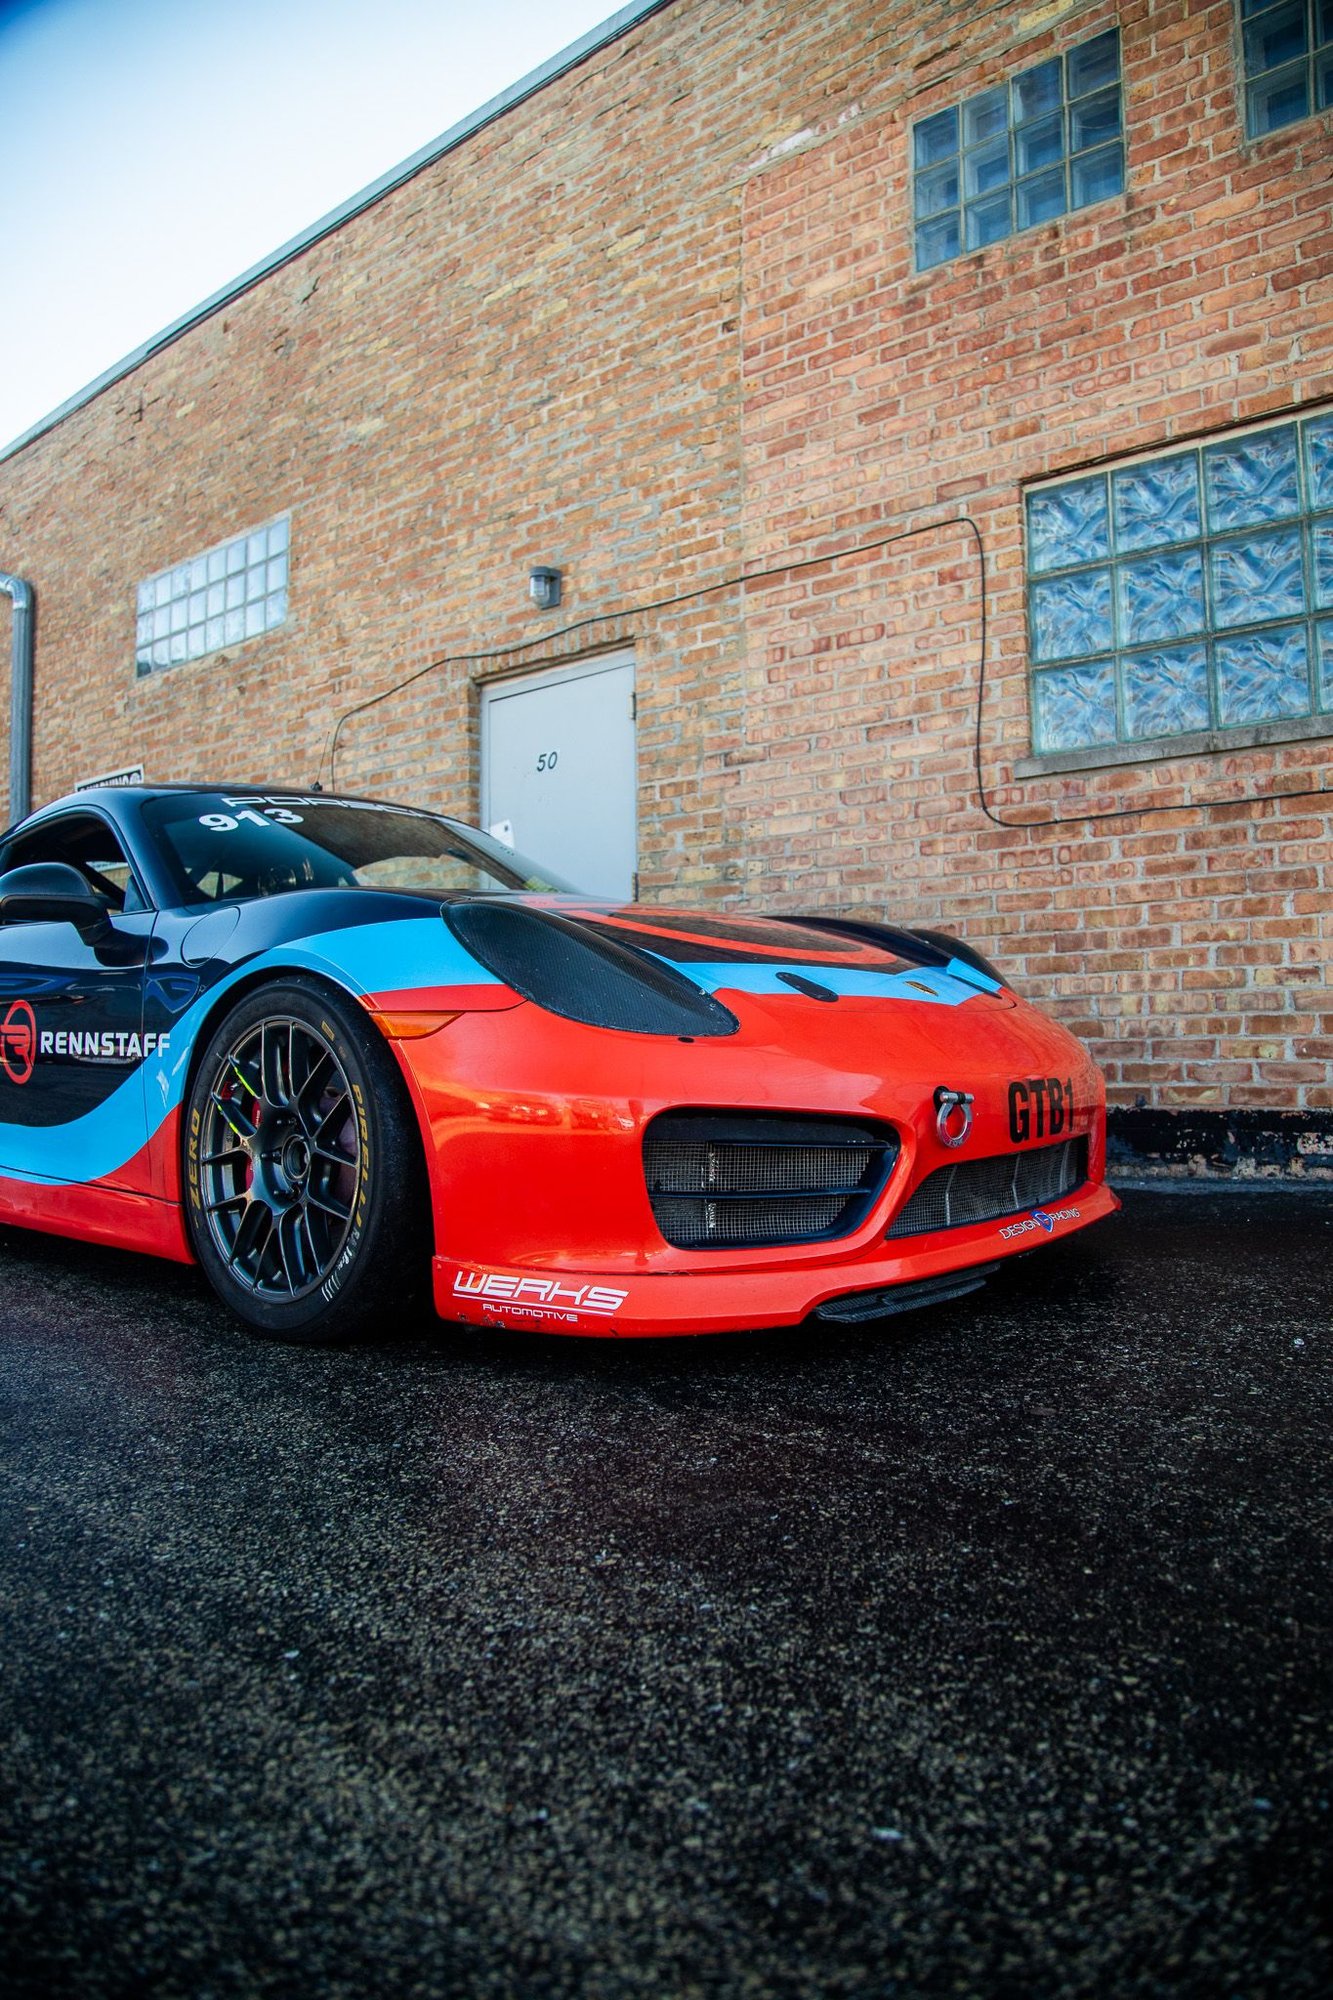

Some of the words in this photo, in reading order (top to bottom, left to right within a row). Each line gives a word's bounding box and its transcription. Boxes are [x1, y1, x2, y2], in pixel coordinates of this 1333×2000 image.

[536, 751, 558, 772] 50
[198, 808, 304, 832] 913
[40, 1031, 171, 1058] RENNSTAFF
[1008, 1077, 1074, 1143] GTB1
[351, 1083, 370, 1228] PIRELLI
[999, 1218, 1041, 1239] DESIGN
[1048, 1208, 1081, 1222] RACING
[453, 1271, 630, 1310] WERKS
[482, 1303, 579, 1322] AUTOMOTIVE
